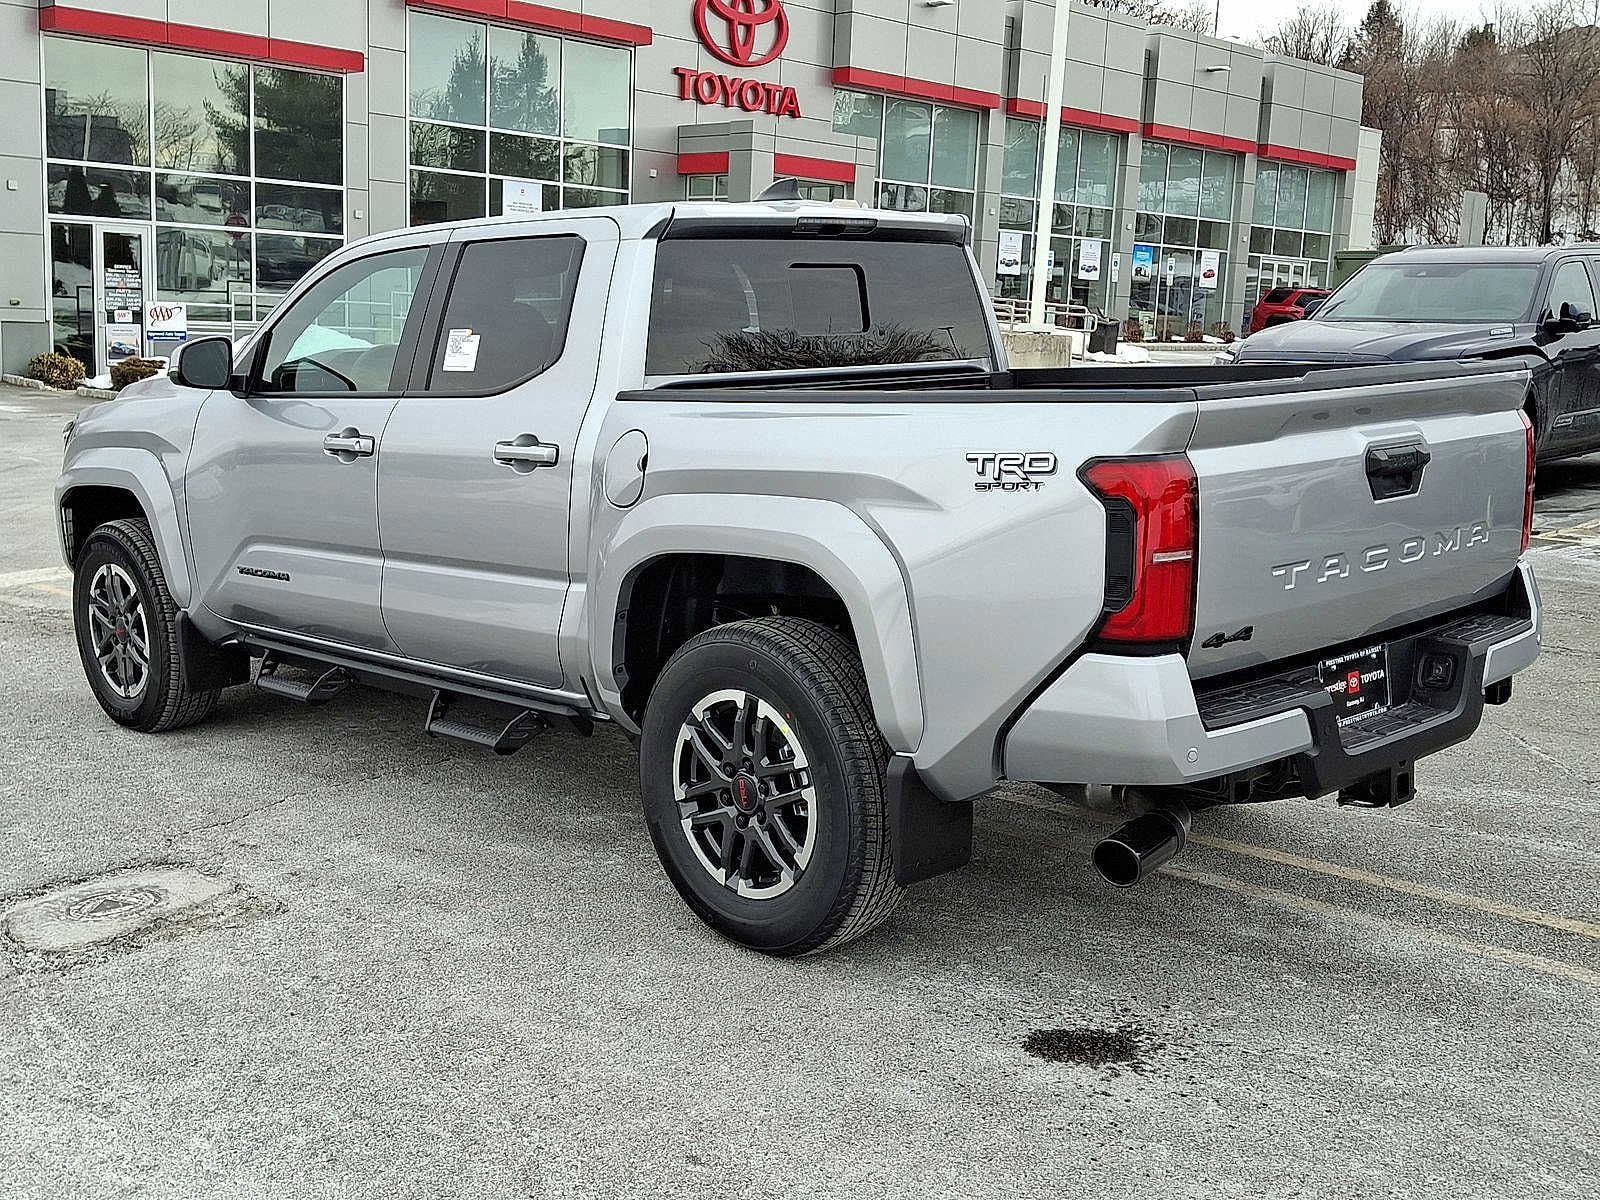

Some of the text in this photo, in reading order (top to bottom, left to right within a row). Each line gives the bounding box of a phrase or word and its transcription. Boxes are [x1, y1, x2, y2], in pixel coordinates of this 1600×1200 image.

[673, 66, 801, 118] TOYOTA
[966, 452, 1058, 481] TRD
[974, 481, 1045, 492] SPORT
[1271, 520, 1489, 590] TACOMA
[236, 565, 292, 582] TACOMA
[1325, 657, 1344, 667] PRESTIGE
[1344, 652, 1359, 662] TOYOTA
[1360, 669, 1384, 684] TOYOTA
